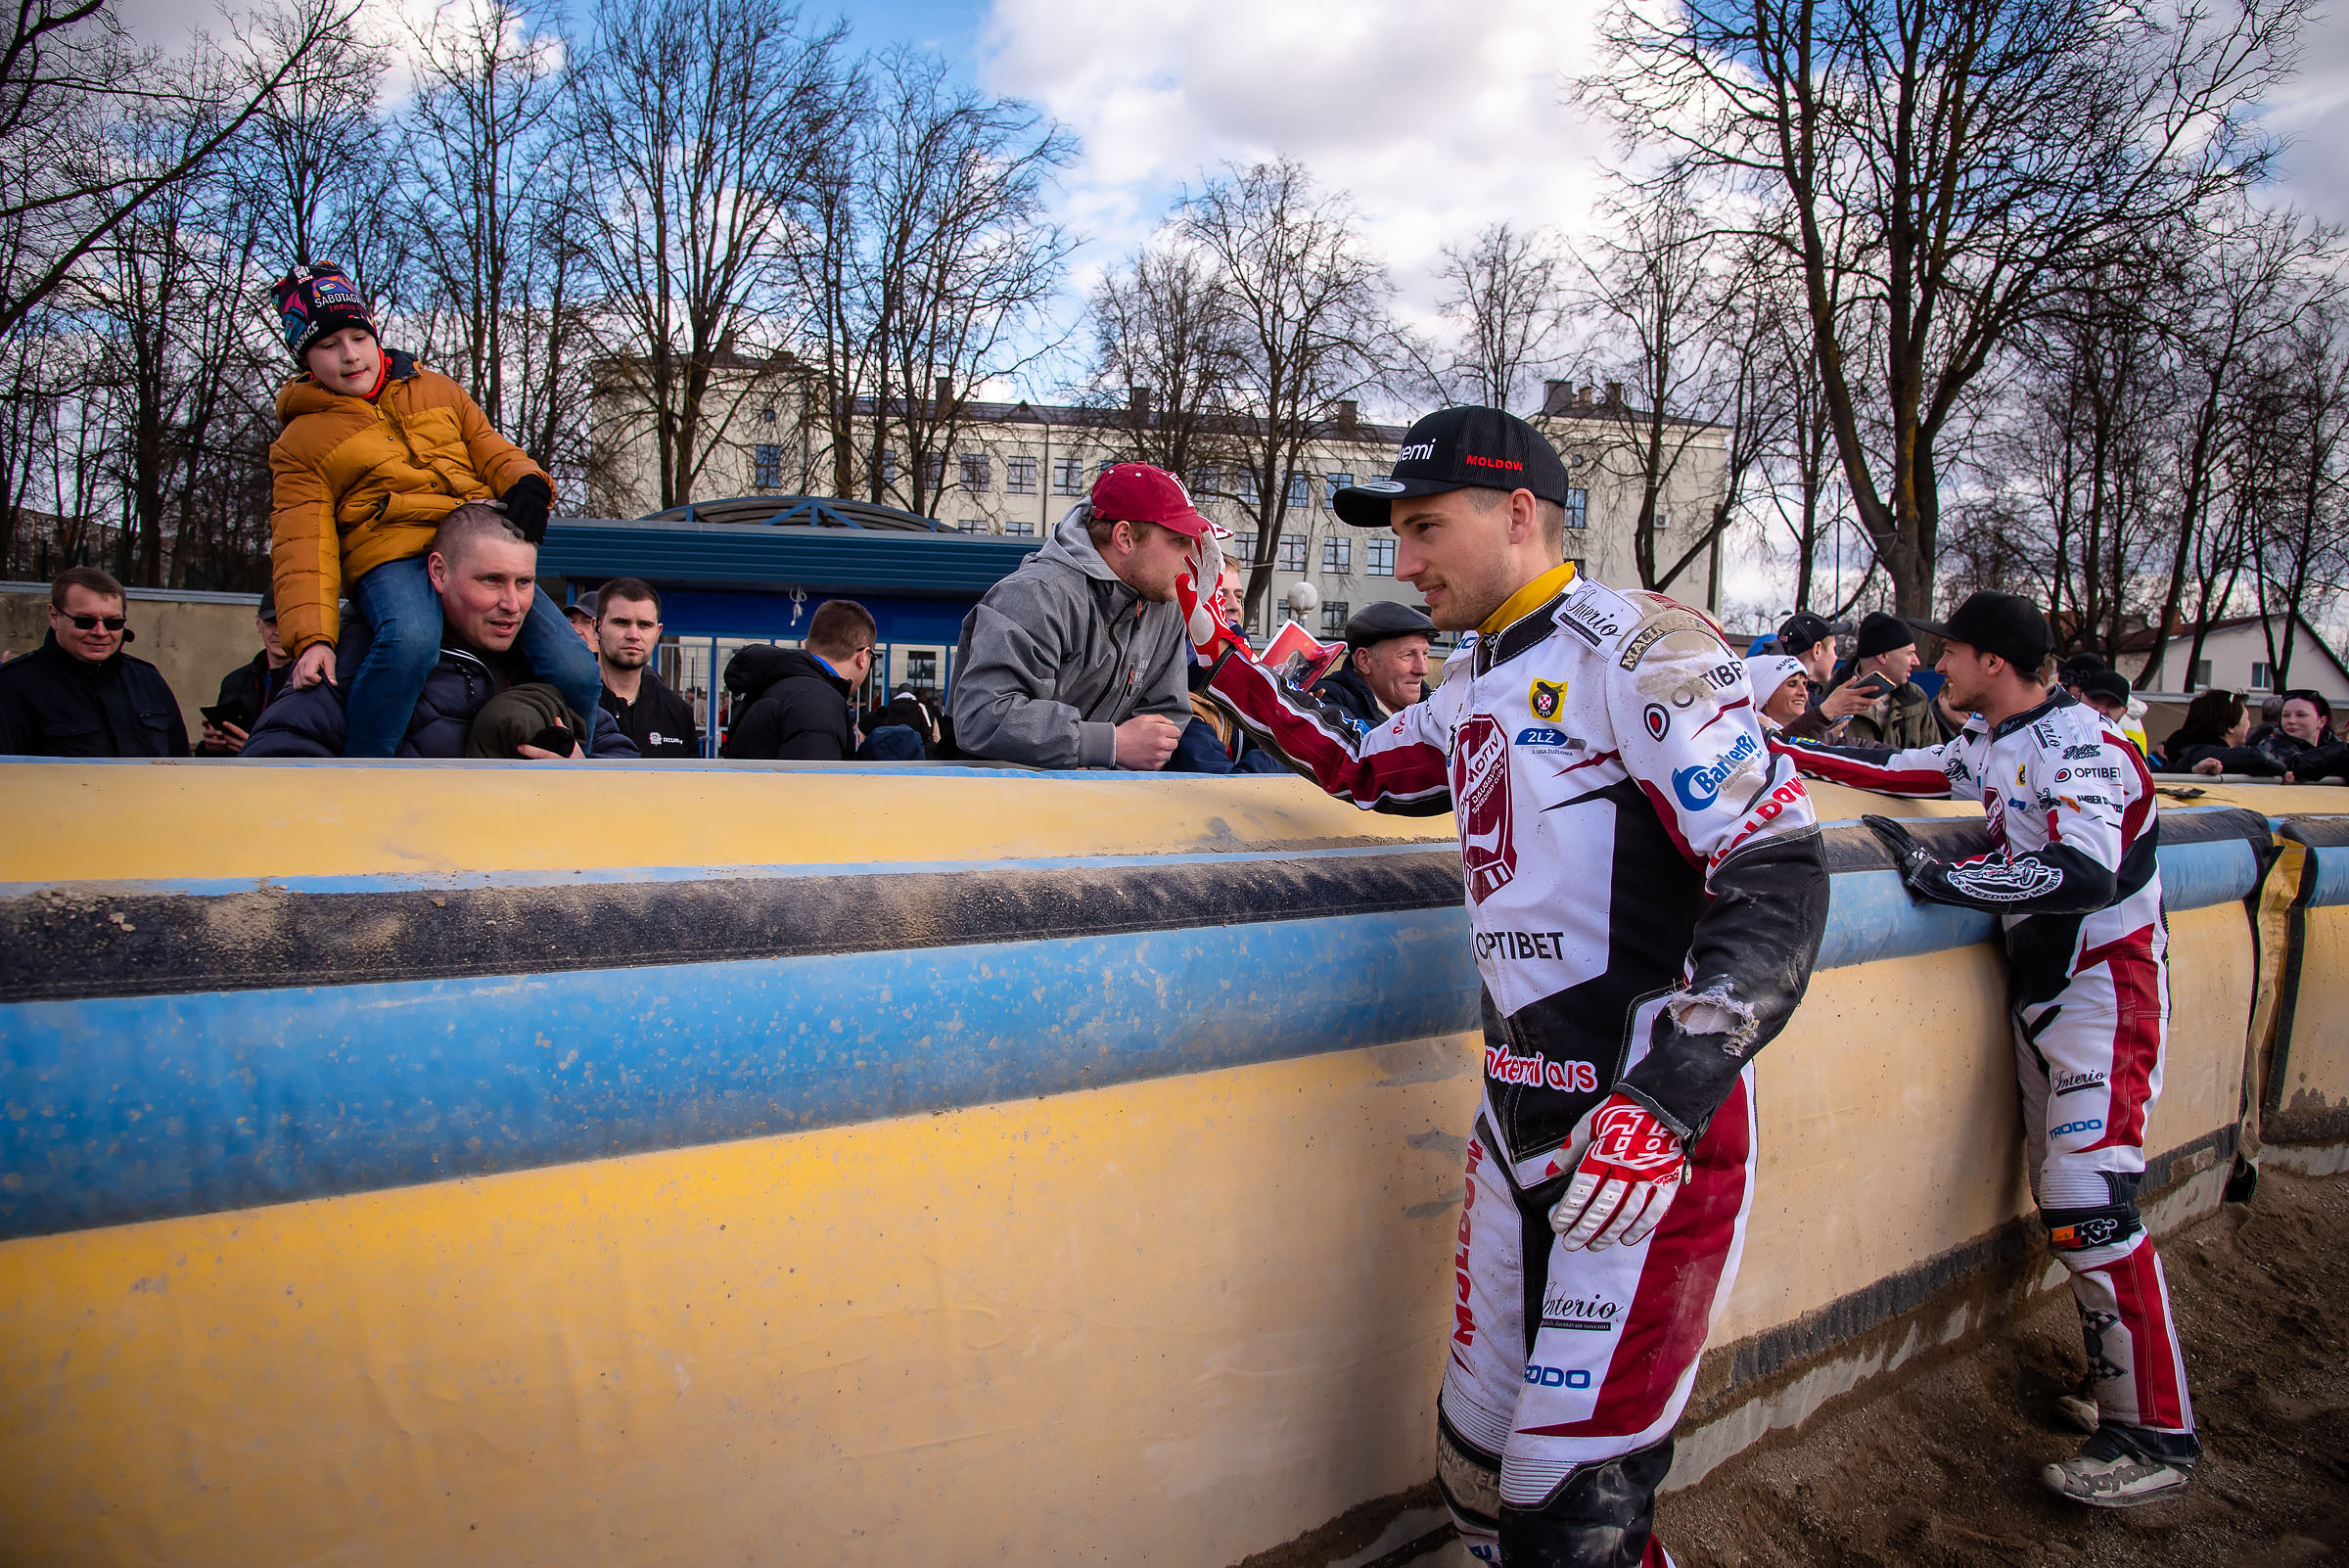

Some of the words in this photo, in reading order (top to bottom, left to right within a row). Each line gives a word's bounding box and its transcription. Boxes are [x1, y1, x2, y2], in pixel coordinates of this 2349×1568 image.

[1466, 454, 1524, 472] MOLDOW
[1565, 584, 1623, 637] Interio
[1527, 729, 1555, 744] 2LŻ
[1961, 885, 2029, 900] SPEEDWAY
[2031, 870, 2060, 897] MUSEUM
[1476, 931, 1565, 960] OPTIBET
[2053, 1069, 2107, 1090] Interio
[2050, 1119, 2103, 1140] TRODO
